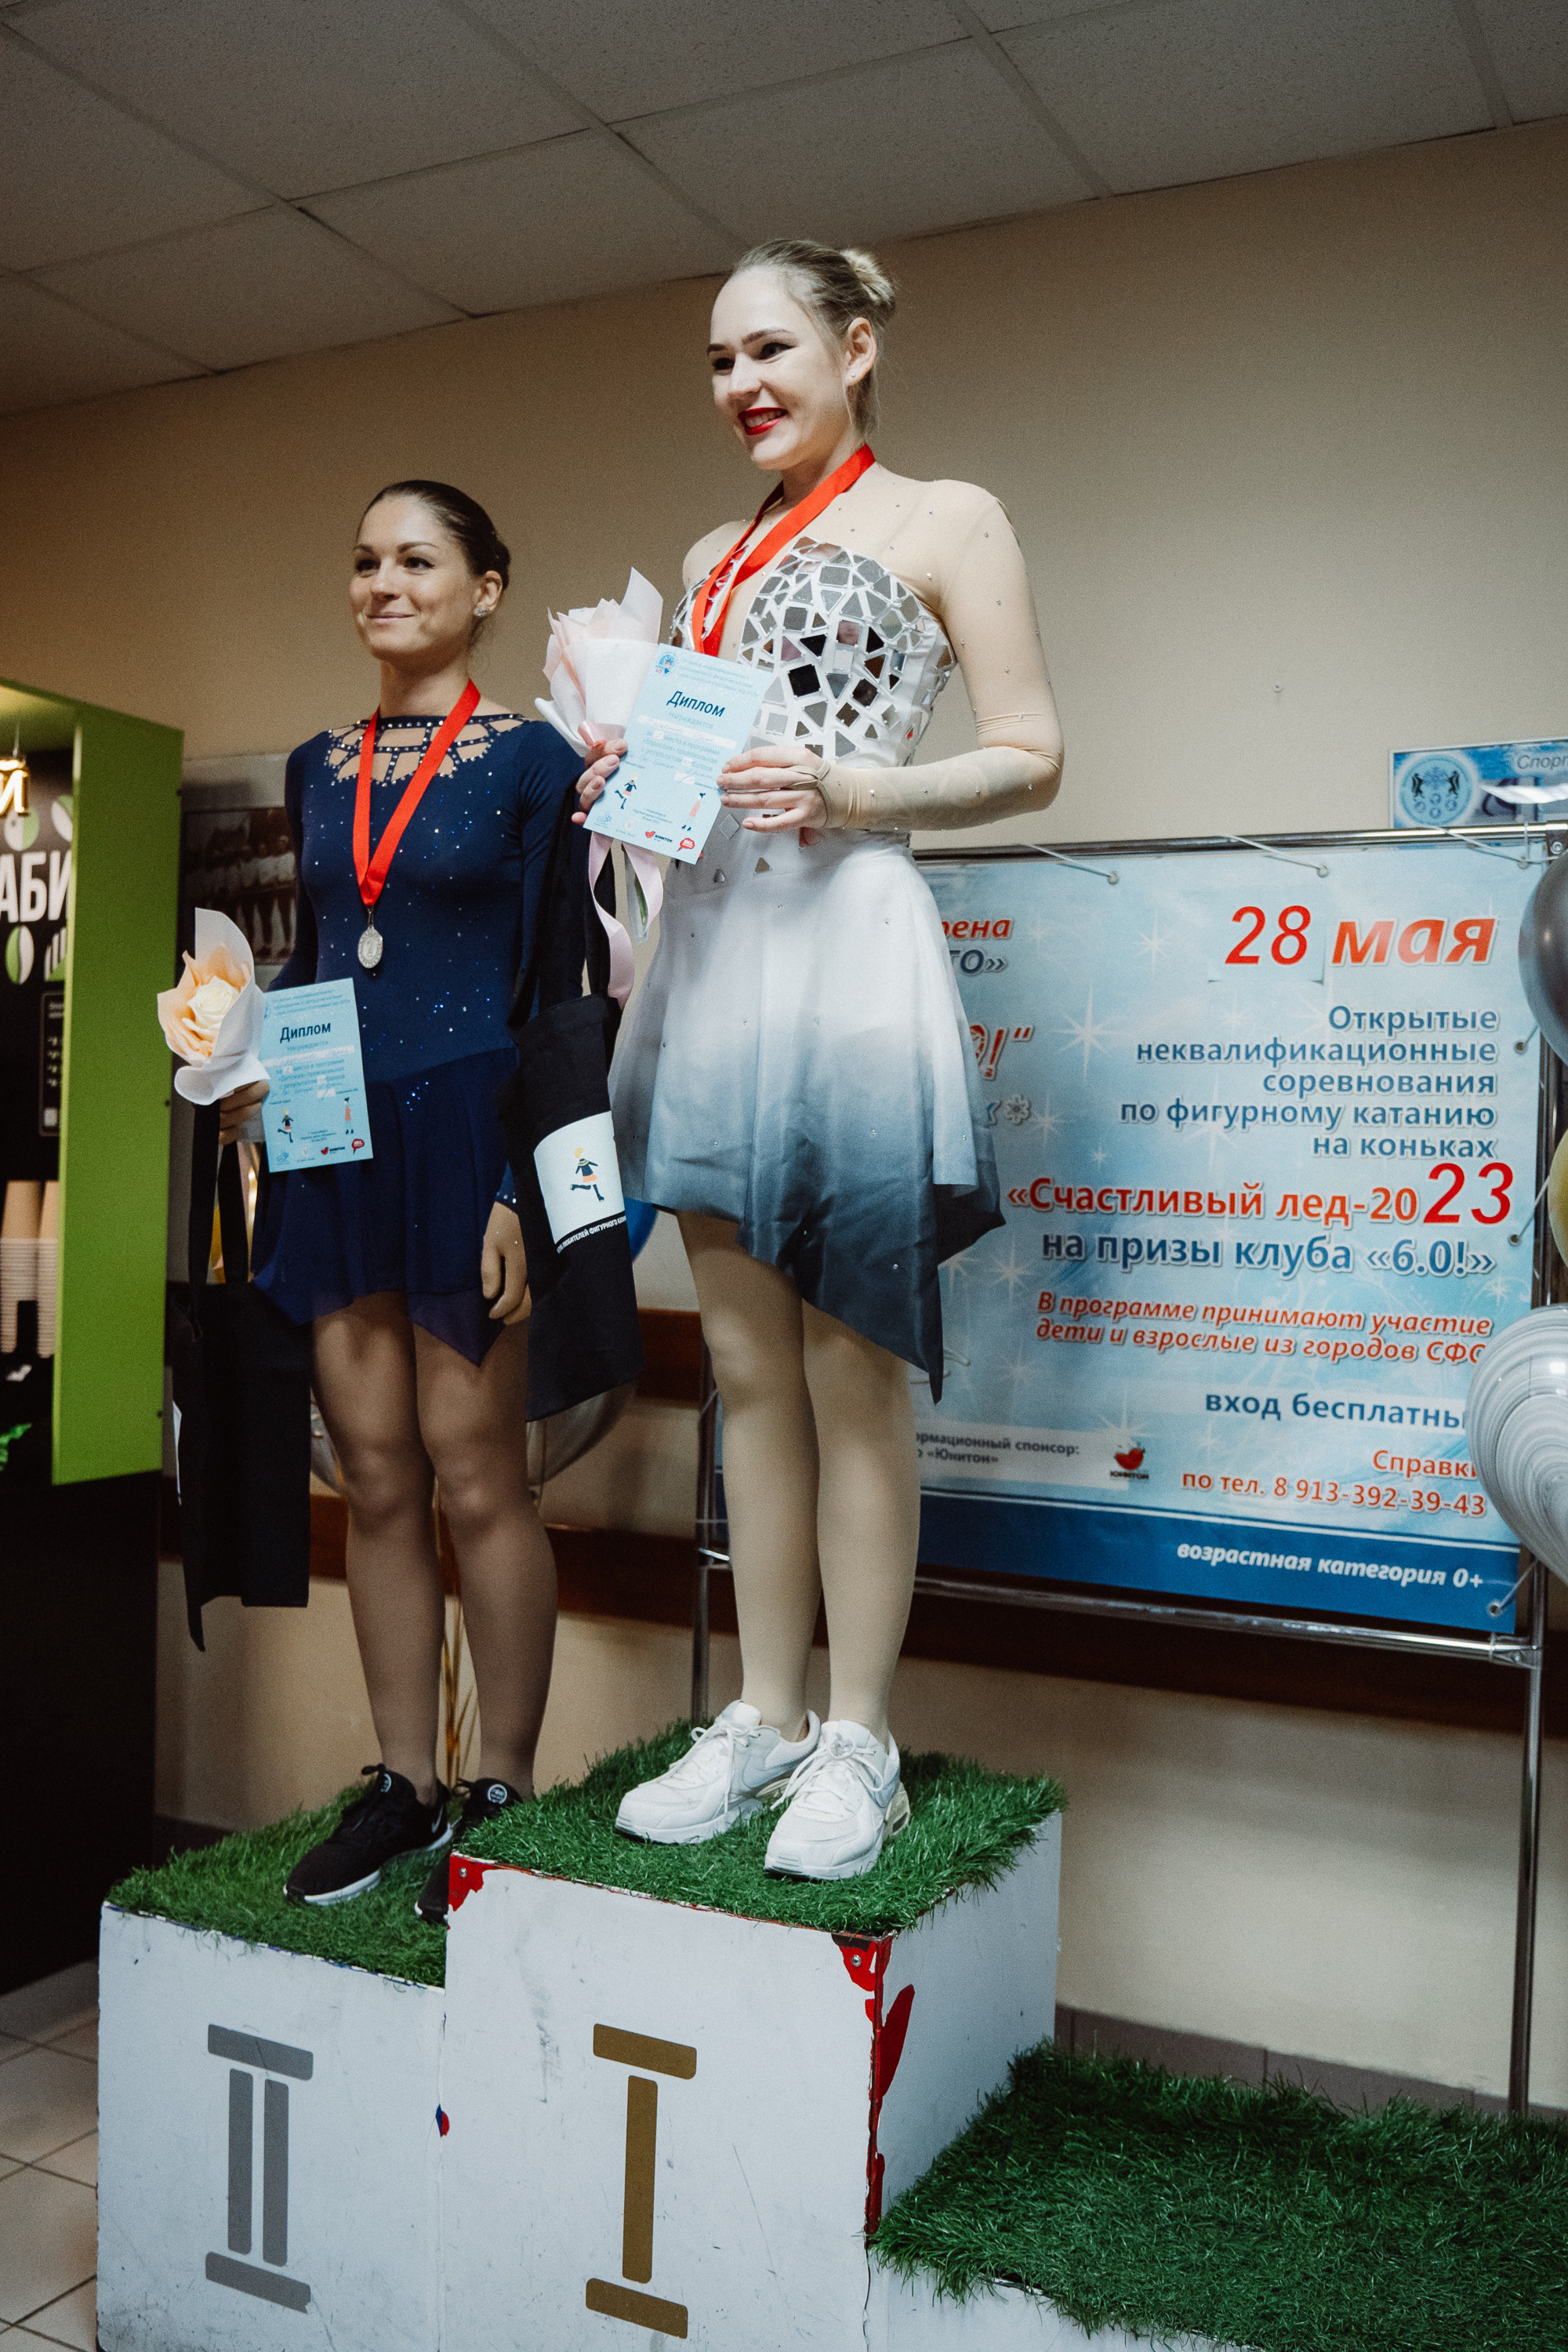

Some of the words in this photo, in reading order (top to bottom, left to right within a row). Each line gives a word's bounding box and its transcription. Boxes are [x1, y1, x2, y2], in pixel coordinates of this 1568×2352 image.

[666, 690, 726, 717] Диплом
[1225, 905, 1312, 966] 28
[1331, 918, 1497, 964] мая
[949, 949, 1005, 975] О»
[279, 1022, 332, 1044] Диплом
[1328, 1005, 1498, 1036] Открытые
[1136, 1036, 1497, 1068] неквалификационные
[1263, 1072, 1496, 1098] соревнования
[1120, 1102, 1156, 1122] по
[1167, 1098, 1341, 1131] фигурному
[1353, 1105, 1495, 1126] катанию
[1312, 1136, 1348, 1156] на
[1360, 1138, 1495, 1158] коньках
[1007, 1177, 1262, 1216] «Счастливый
[589, 1218, 618, 1235] ФИГУРНОГО
[1043, 1234, 1083, 1258] на
[1098, 1236, 1220, 1269] призы
[1236, 1235, 1352, 1277] клуба
[1367, 1239, 1494, 1276] «6.0!»
[1037, 1291, 1053, 1311] В
[1059, 1297, 1195, 1321] программе
[1201, 1305, 1364, 1329] принимают
[1369, 1314, 1490, 1335] участие
[1036, 1318, 1101, 1341] дети
[1109, 1327, 1124, 1343] и
[1133, 1329, 1254, 1351] взрослые
[1265, 1338, 1293, 1353] из
[1302, 1337, 1415, 1362] городов
[1205, 1393, 1281, 1421] вход
[1292, 1392, 1466, 1429] бесплатны
[1014, 1439, 1080, 1457] спонсор:
[1182, 1472, 1212, 1489] по
[1221, 1476, 1265, 1495] тел.
[1274, 1476, 1287, 1497] 8
[1296, 1479, 1485, 1515] 913-392-39-43
[1177, 1543, 1312, 1572] возрастная
[1317, 1557, 1447, 1588] категория
[1452, 1567, 1483, 1588] 0+
